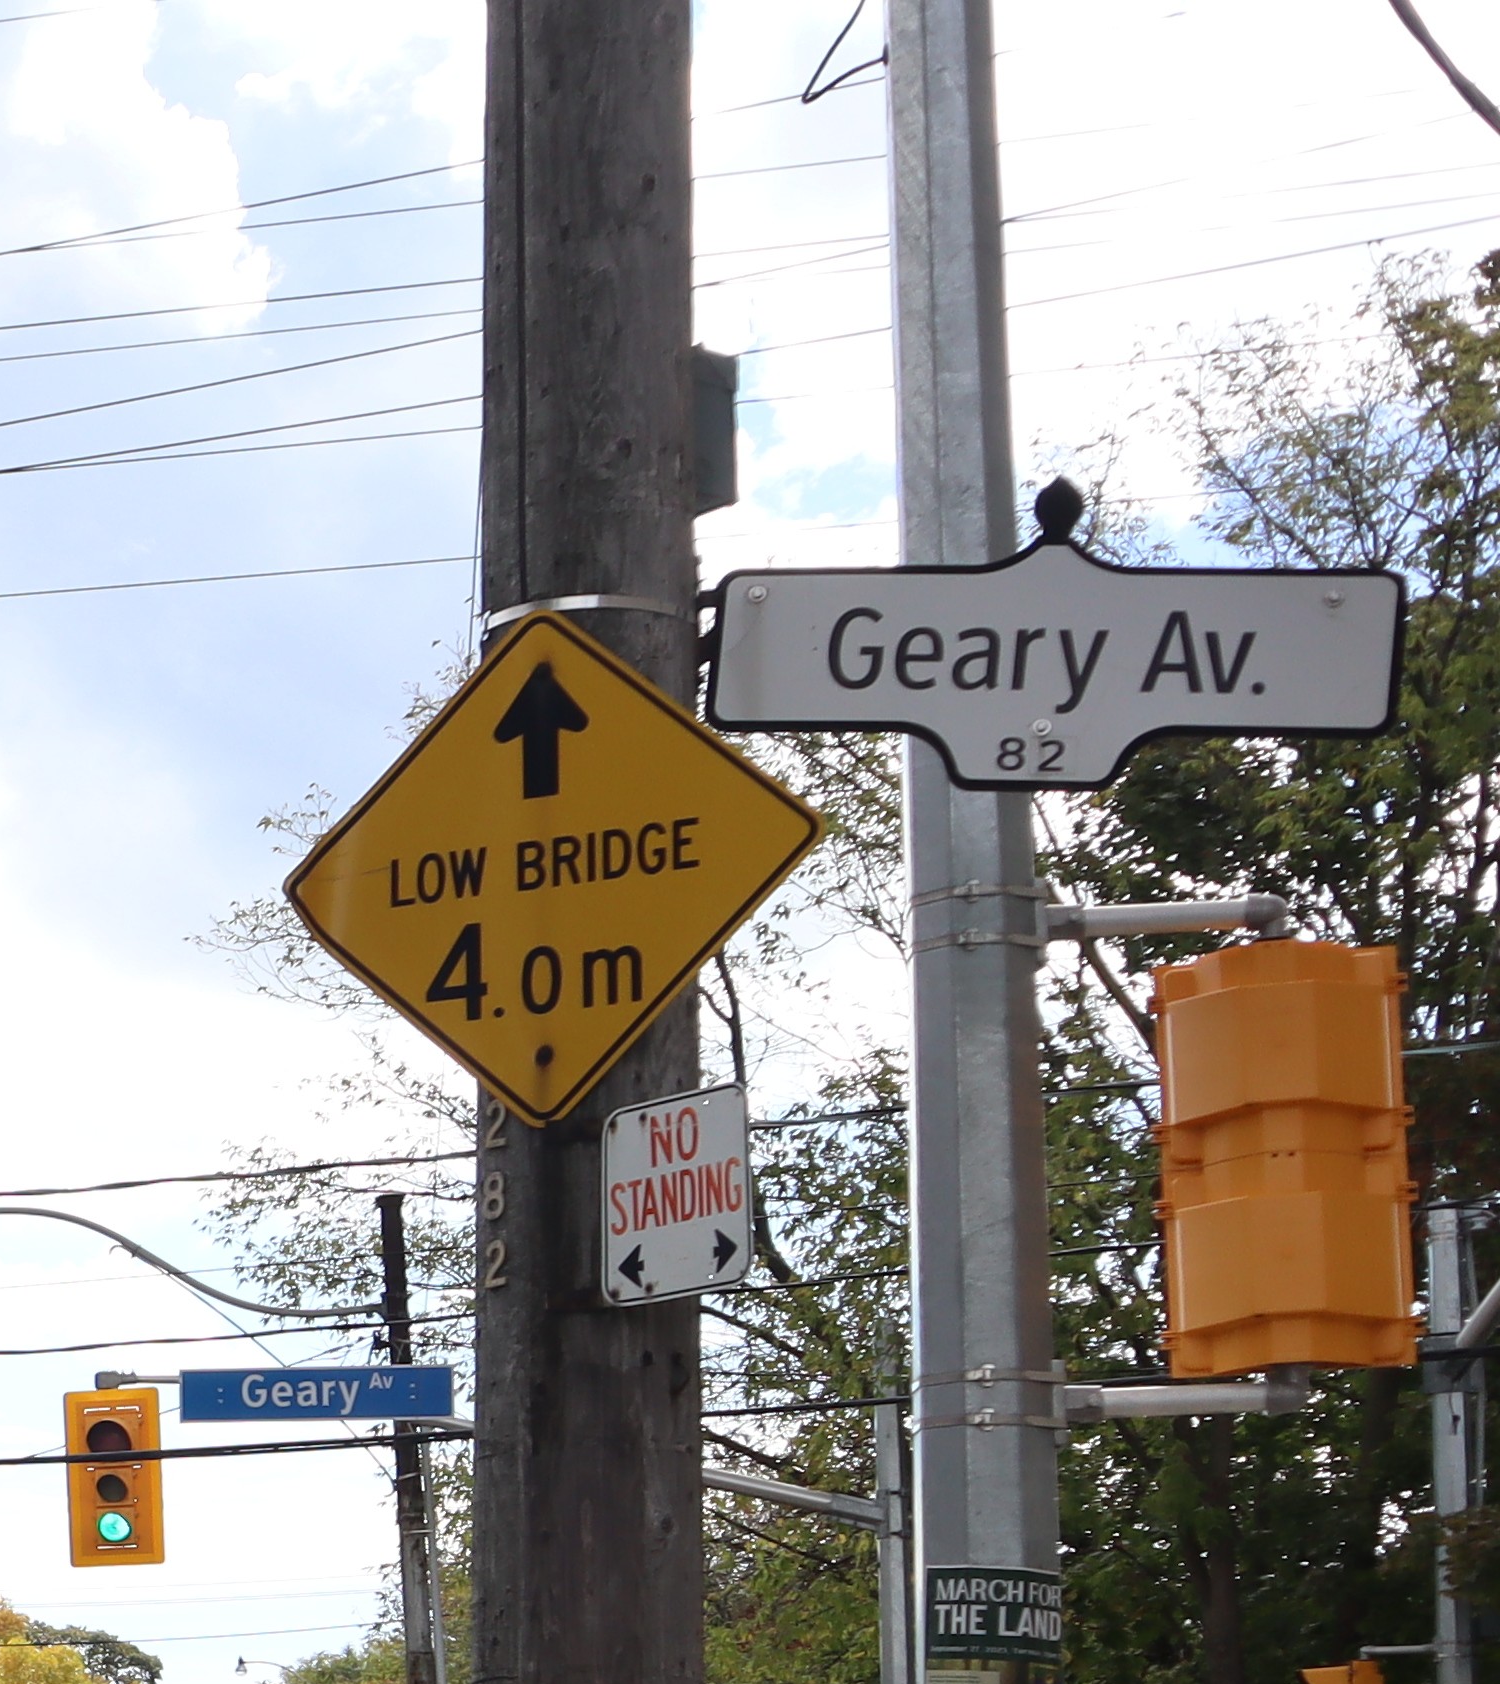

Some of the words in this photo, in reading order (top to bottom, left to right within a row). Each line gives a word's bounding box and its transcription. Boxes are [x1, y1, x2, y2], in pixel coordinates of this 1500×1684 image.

[827, 606, 1108, 714] Geary
[1140, 609, 1266, 698] Av.
[994, 733, 1067, 775] 82
[388, 846, 487, 910] LOW
[515, 815, 702, 893] BRIDGE
[649, 1106, 699, 1168] NO
[610, 1156, 743, 1236] STANDING
[240, 1372, 361, 1416] Geary
[368, 1371, 395, 1391] Av
[934, 1578, 1024, 1603] MARCH
[1029, 1582, 1062, 1608] FOR
[933, 1604, 989, 1635] THE
[997, 1605, 1062, 1642] LAND
